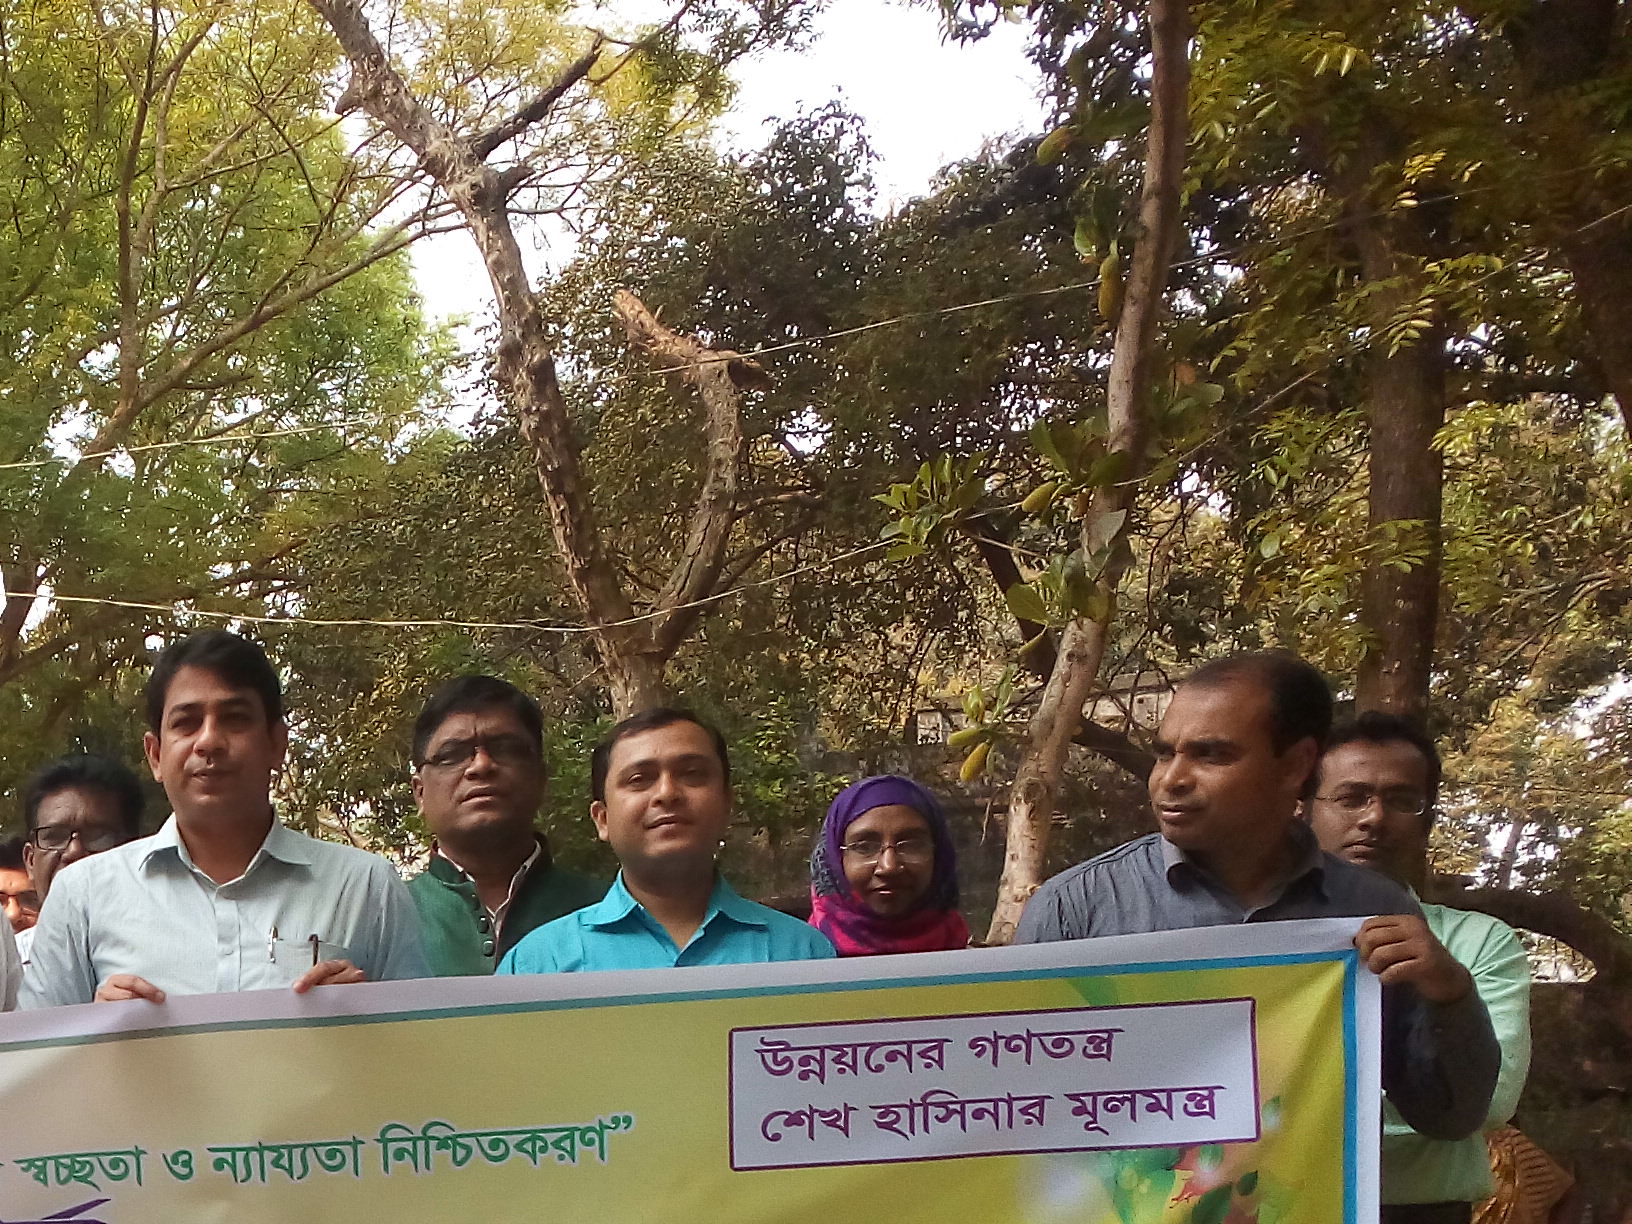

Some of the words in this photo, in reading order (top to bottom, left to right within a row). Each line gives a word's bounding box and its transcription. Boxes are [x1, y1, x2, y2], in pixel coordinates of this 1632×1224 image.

[754, 1036, 953, 1085] উন্নয়নের
[968, 1027, 1124, 1068] গণতন্ত্র
[761, 1103, 859, 1143] শেখ
[869, 1088, 1054, 1141] হাসিনার
[1068, 1084, 1227, 1135] মূলমন্ত্র
[14, 1145, 146, 1190] স্বচ্ছতা
[162, 1149, 194, 1181] ও
[207, 1135, 364, 1184] ন্যায্যতা
